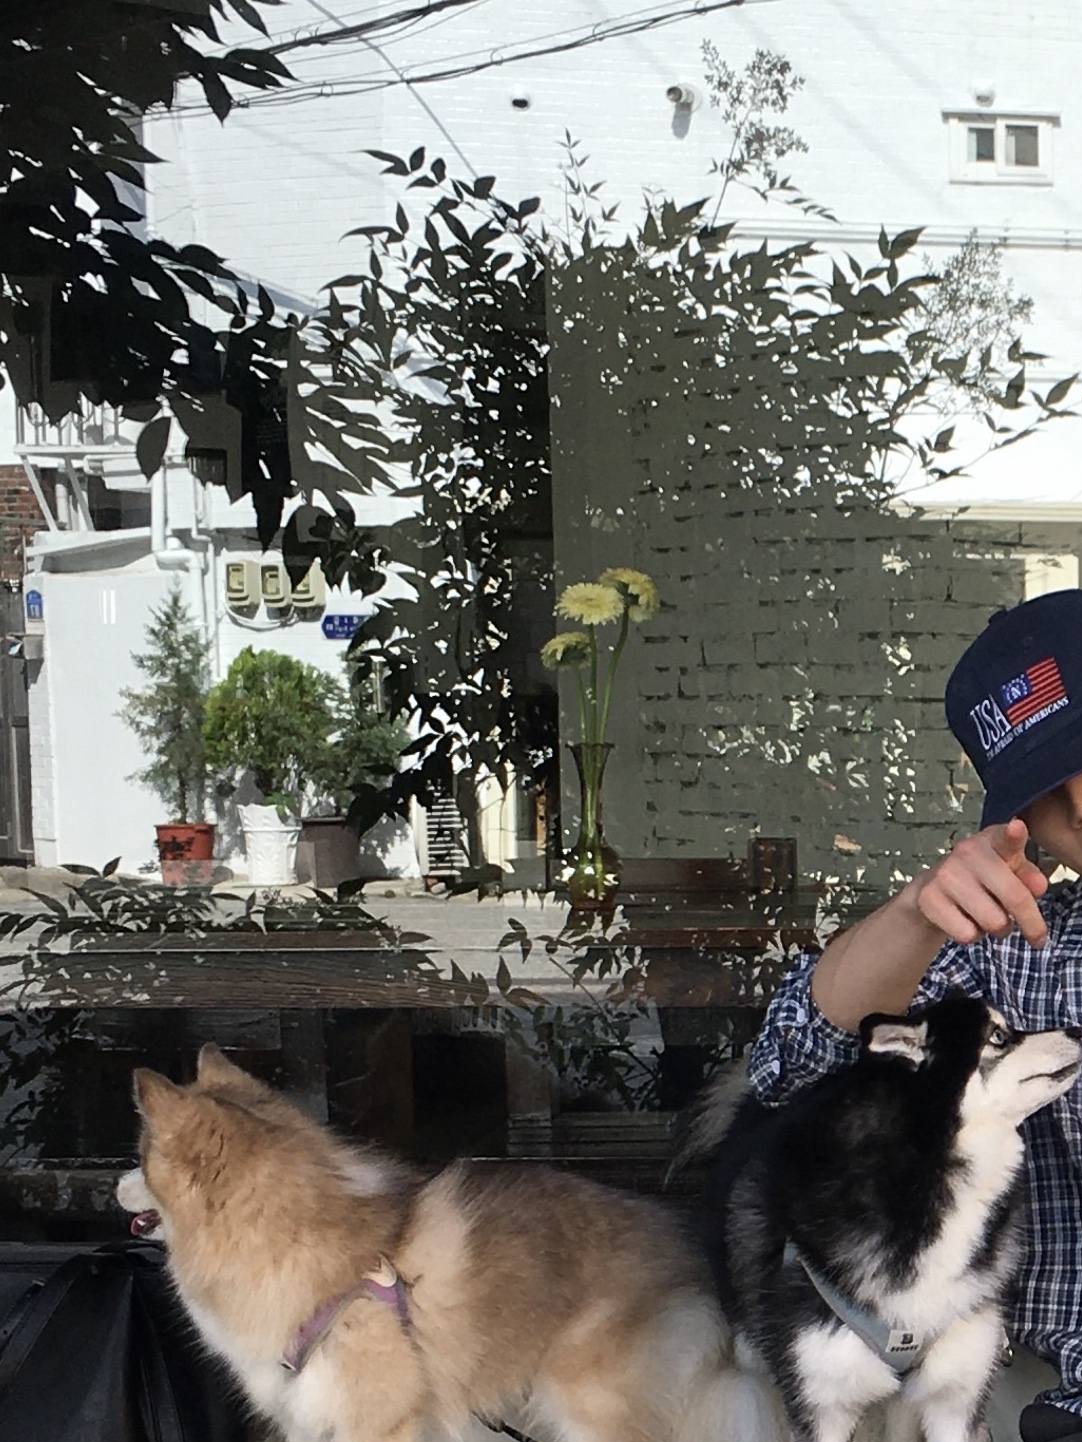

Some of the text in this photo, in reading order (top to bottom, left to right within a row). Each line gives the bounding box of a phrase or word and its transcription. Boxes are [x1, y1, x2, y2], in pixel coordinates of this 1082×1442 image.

[969, 693, 1012, 751] USA
[1013, 722, 1024, 737] OF
[1024, 696, 1070, 731] AMERICANS
